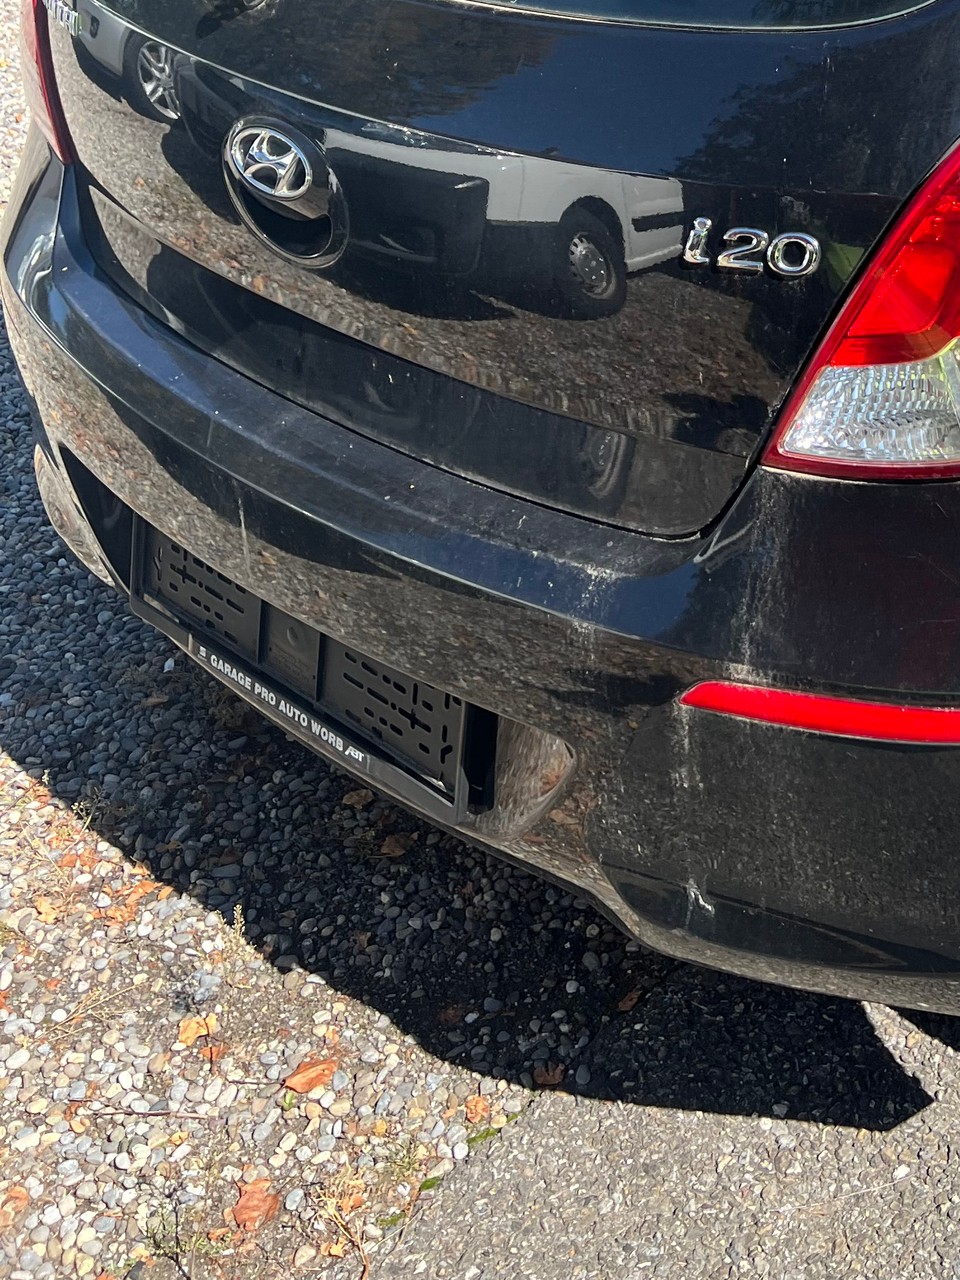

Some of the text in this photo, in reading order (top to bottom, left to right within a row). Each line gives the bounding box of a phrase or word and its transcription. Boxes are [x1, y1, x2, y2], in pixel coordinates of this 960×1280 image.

[683, 216, 821, 276] i20
[210, 655, 252, 690] GARAGE
[254, 682, 276, 705] PRO
[279, 700, 308, 727] AUTO
[311, 719, 344, 752] WORB
